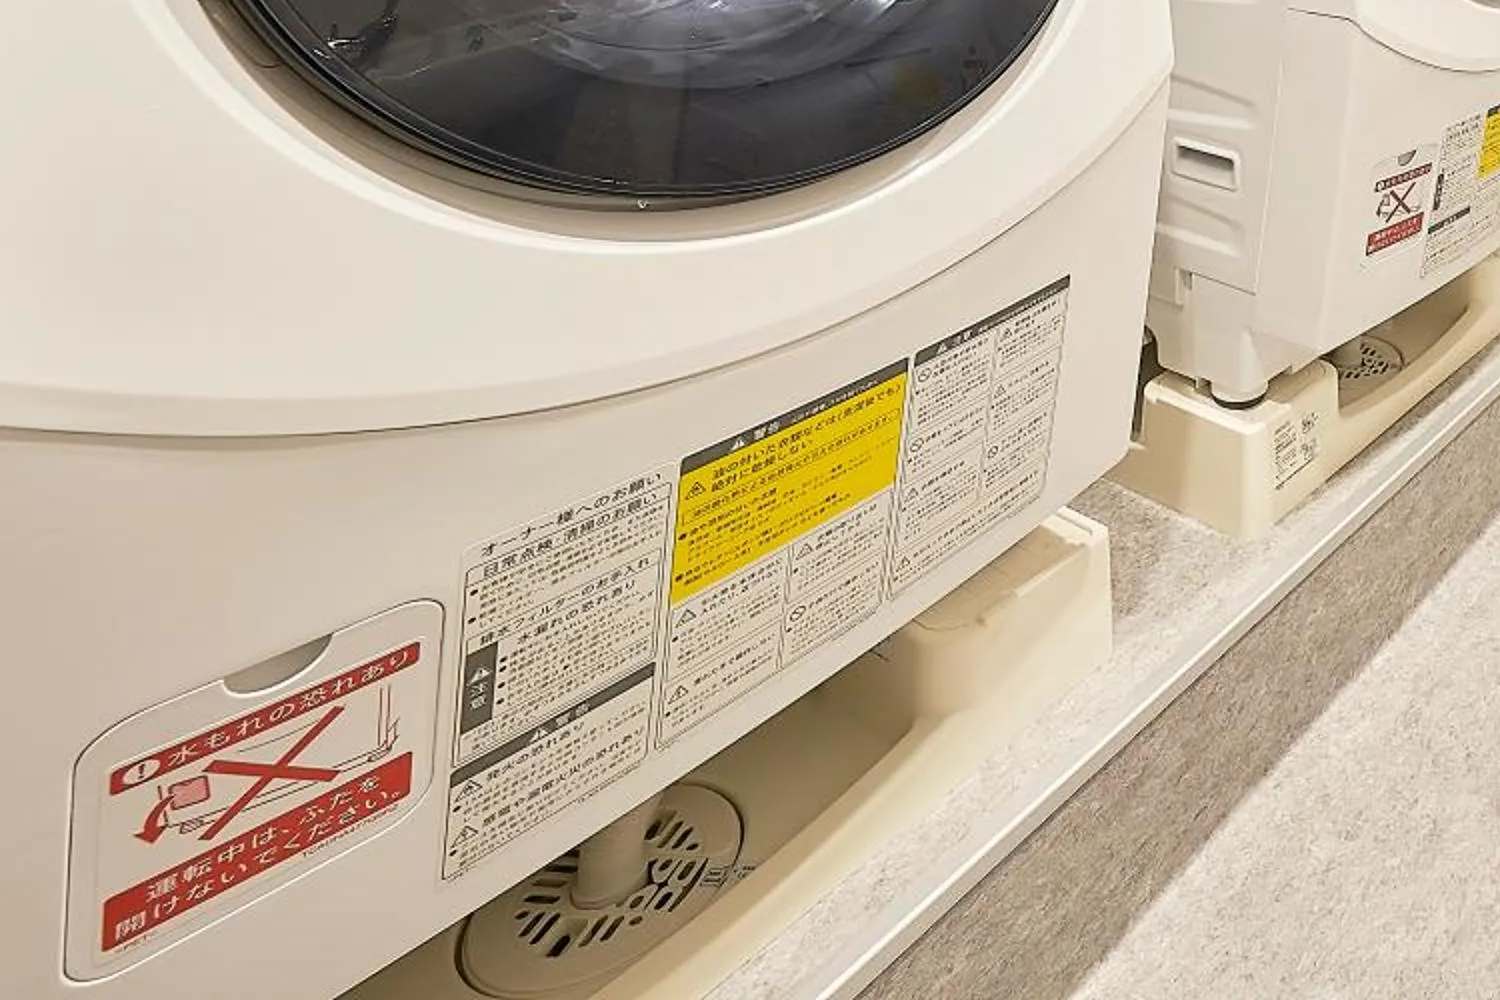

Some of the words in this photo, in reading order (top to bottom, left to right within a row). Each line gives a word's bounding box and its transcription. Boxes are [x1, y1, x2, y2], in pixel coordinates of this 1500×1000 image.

[479, 470, 662, 559] オーナー様へのお願い
[478, 553, 650, 648] 排水フィルターのお手入れ
[168, 650, 409, 765] 水もれの恐れあり
[114, 791, 400, 939] 開けないでください。
[145, 775, 380, 903] 運転中は、ふたを
